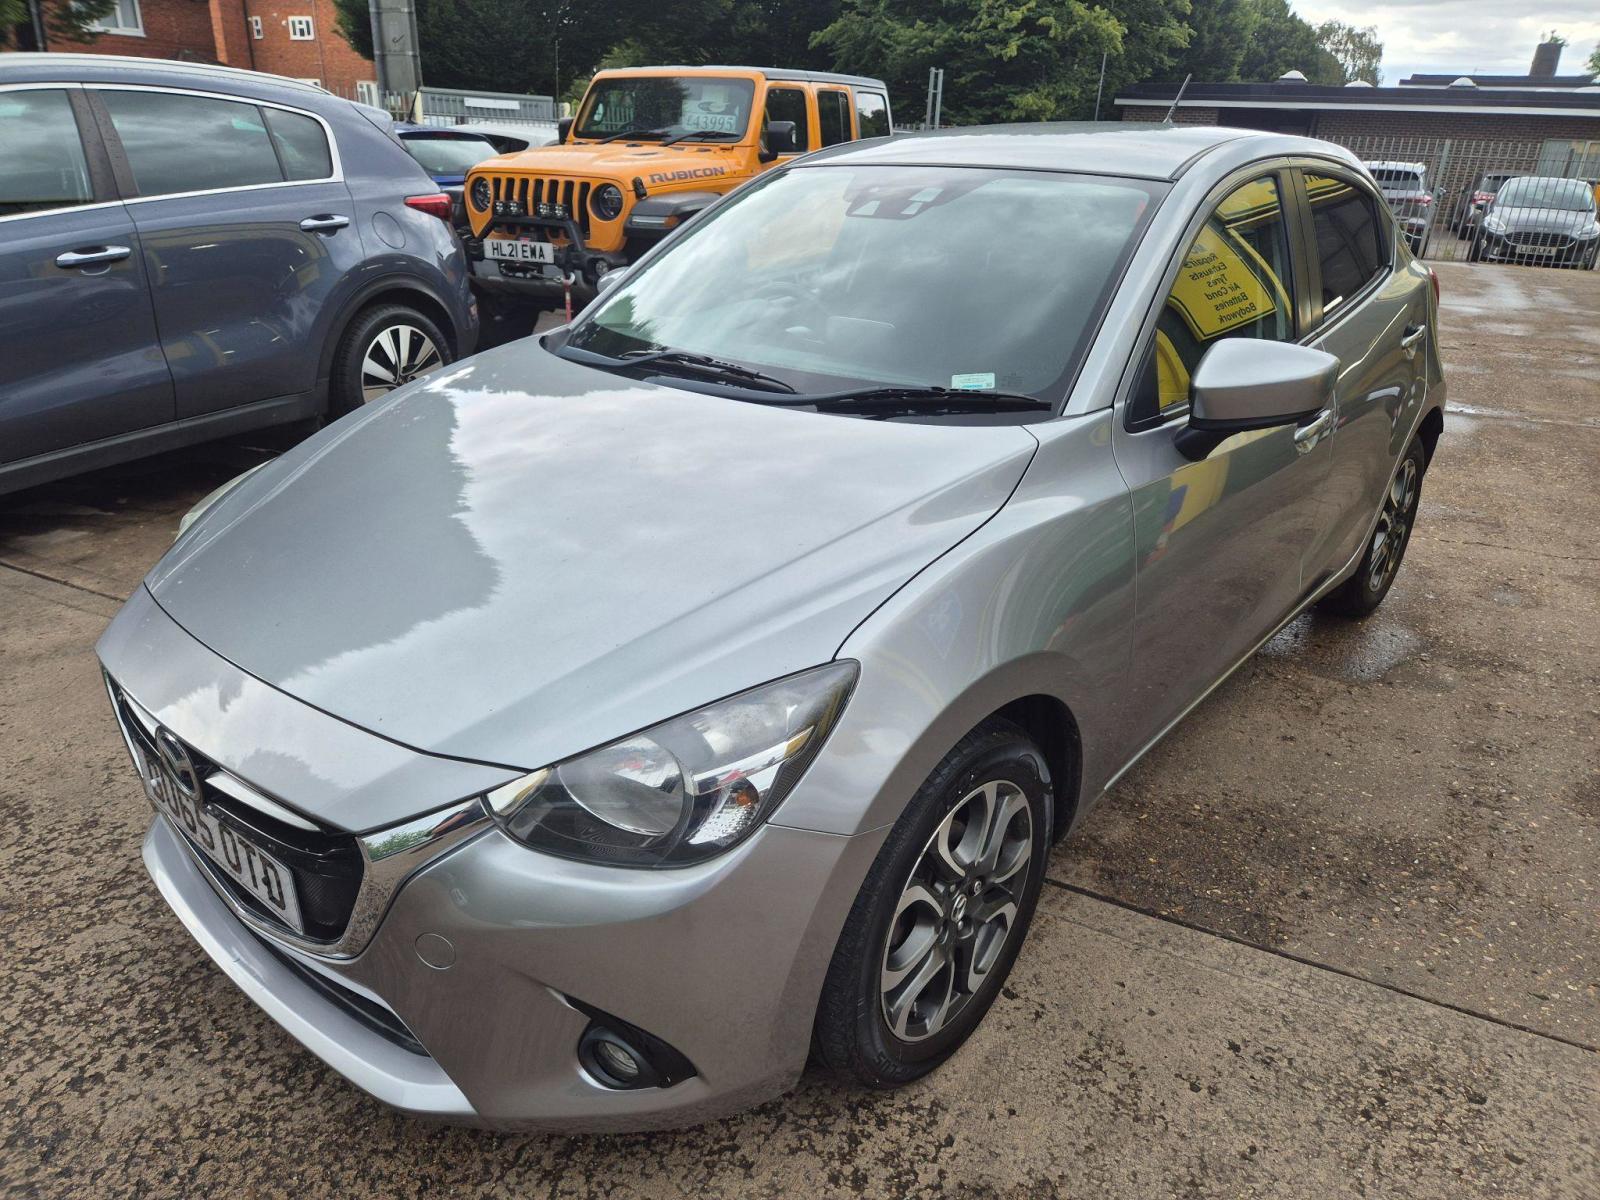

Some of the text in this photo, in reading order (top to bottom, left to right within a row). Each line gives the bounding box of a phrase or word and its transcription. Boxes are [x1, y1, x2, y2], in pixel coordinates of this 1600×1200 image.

[648, 166, 725, 184] RUBICON
[491, 241, 545, 260] HL21 EWA
[218, 821, 286, 911] OTD
